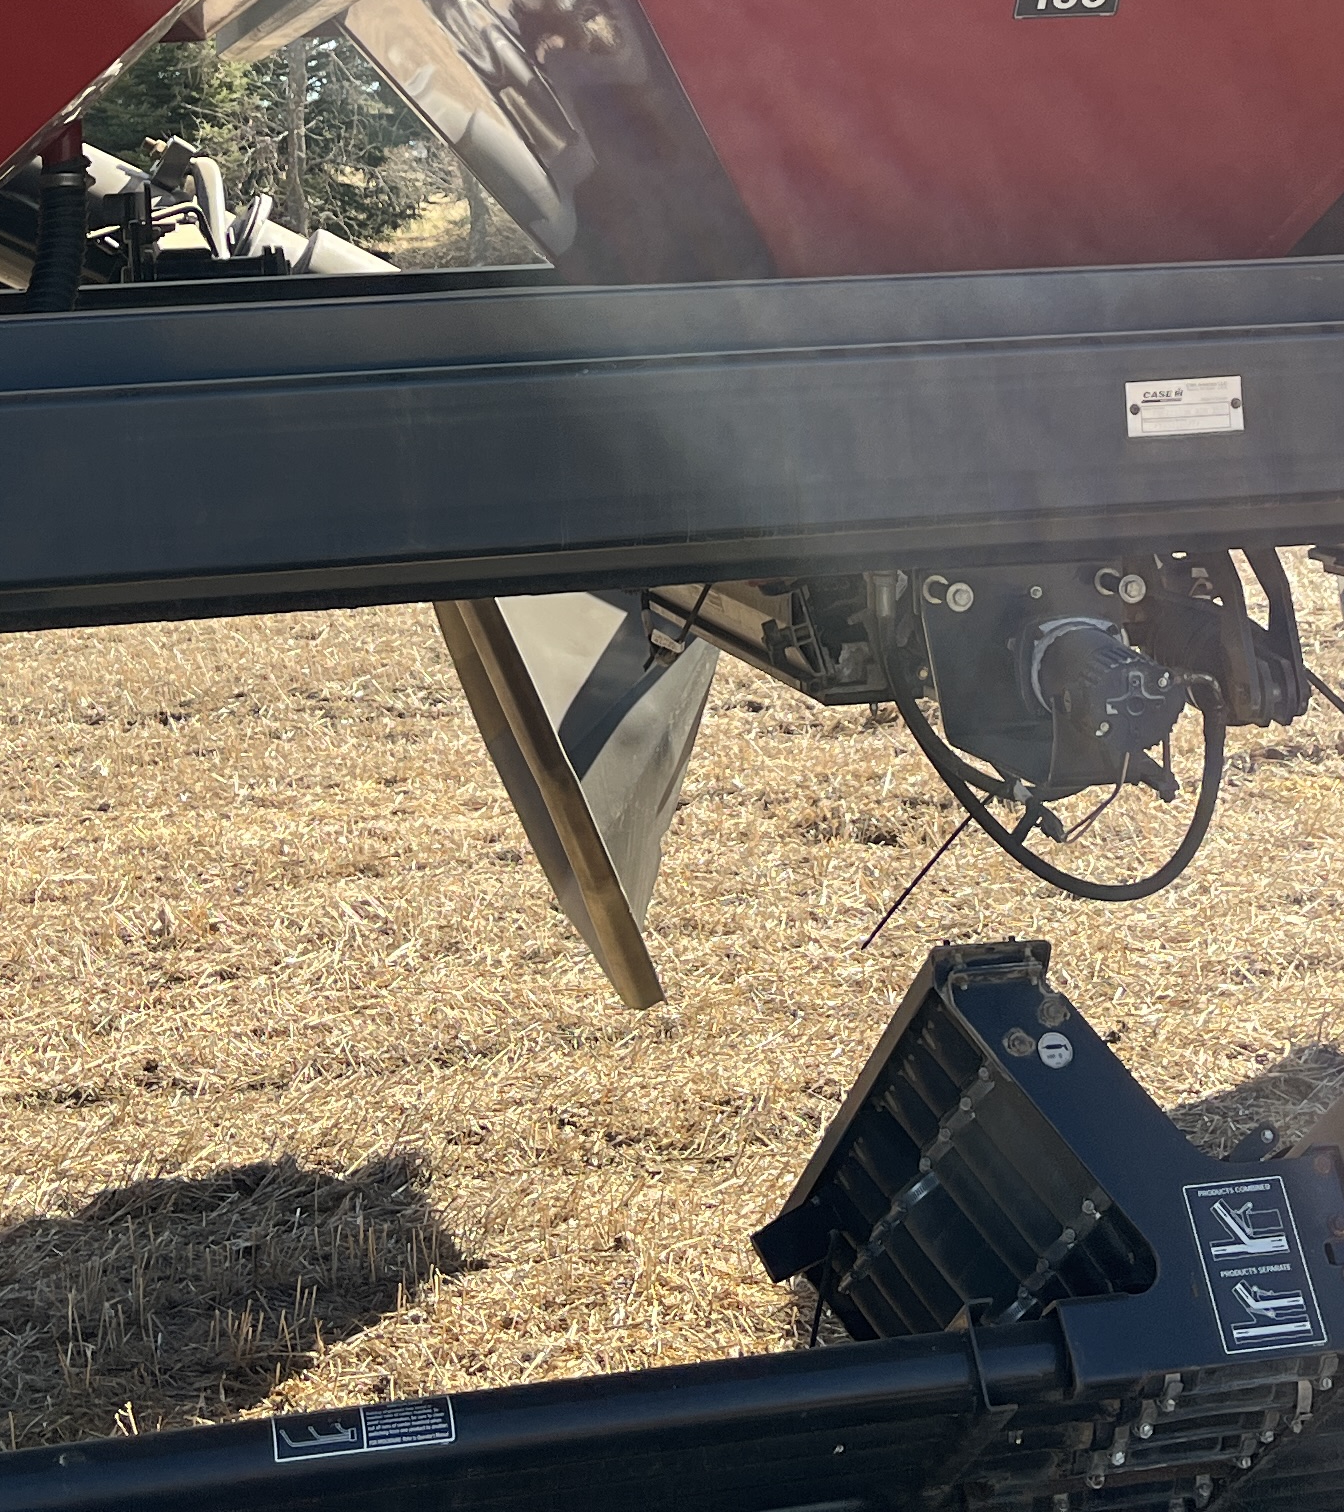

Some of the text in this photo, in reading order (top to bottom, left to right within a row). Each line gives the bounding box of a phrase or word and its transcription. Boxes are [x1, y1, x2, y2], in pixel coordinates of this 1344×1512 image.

[1143, 390, 1172, 399] CASE
[1197, 1187, 1234, 1197] PRODUCTS
[1220, 1267, 1257, 1277] PRODUCTS
